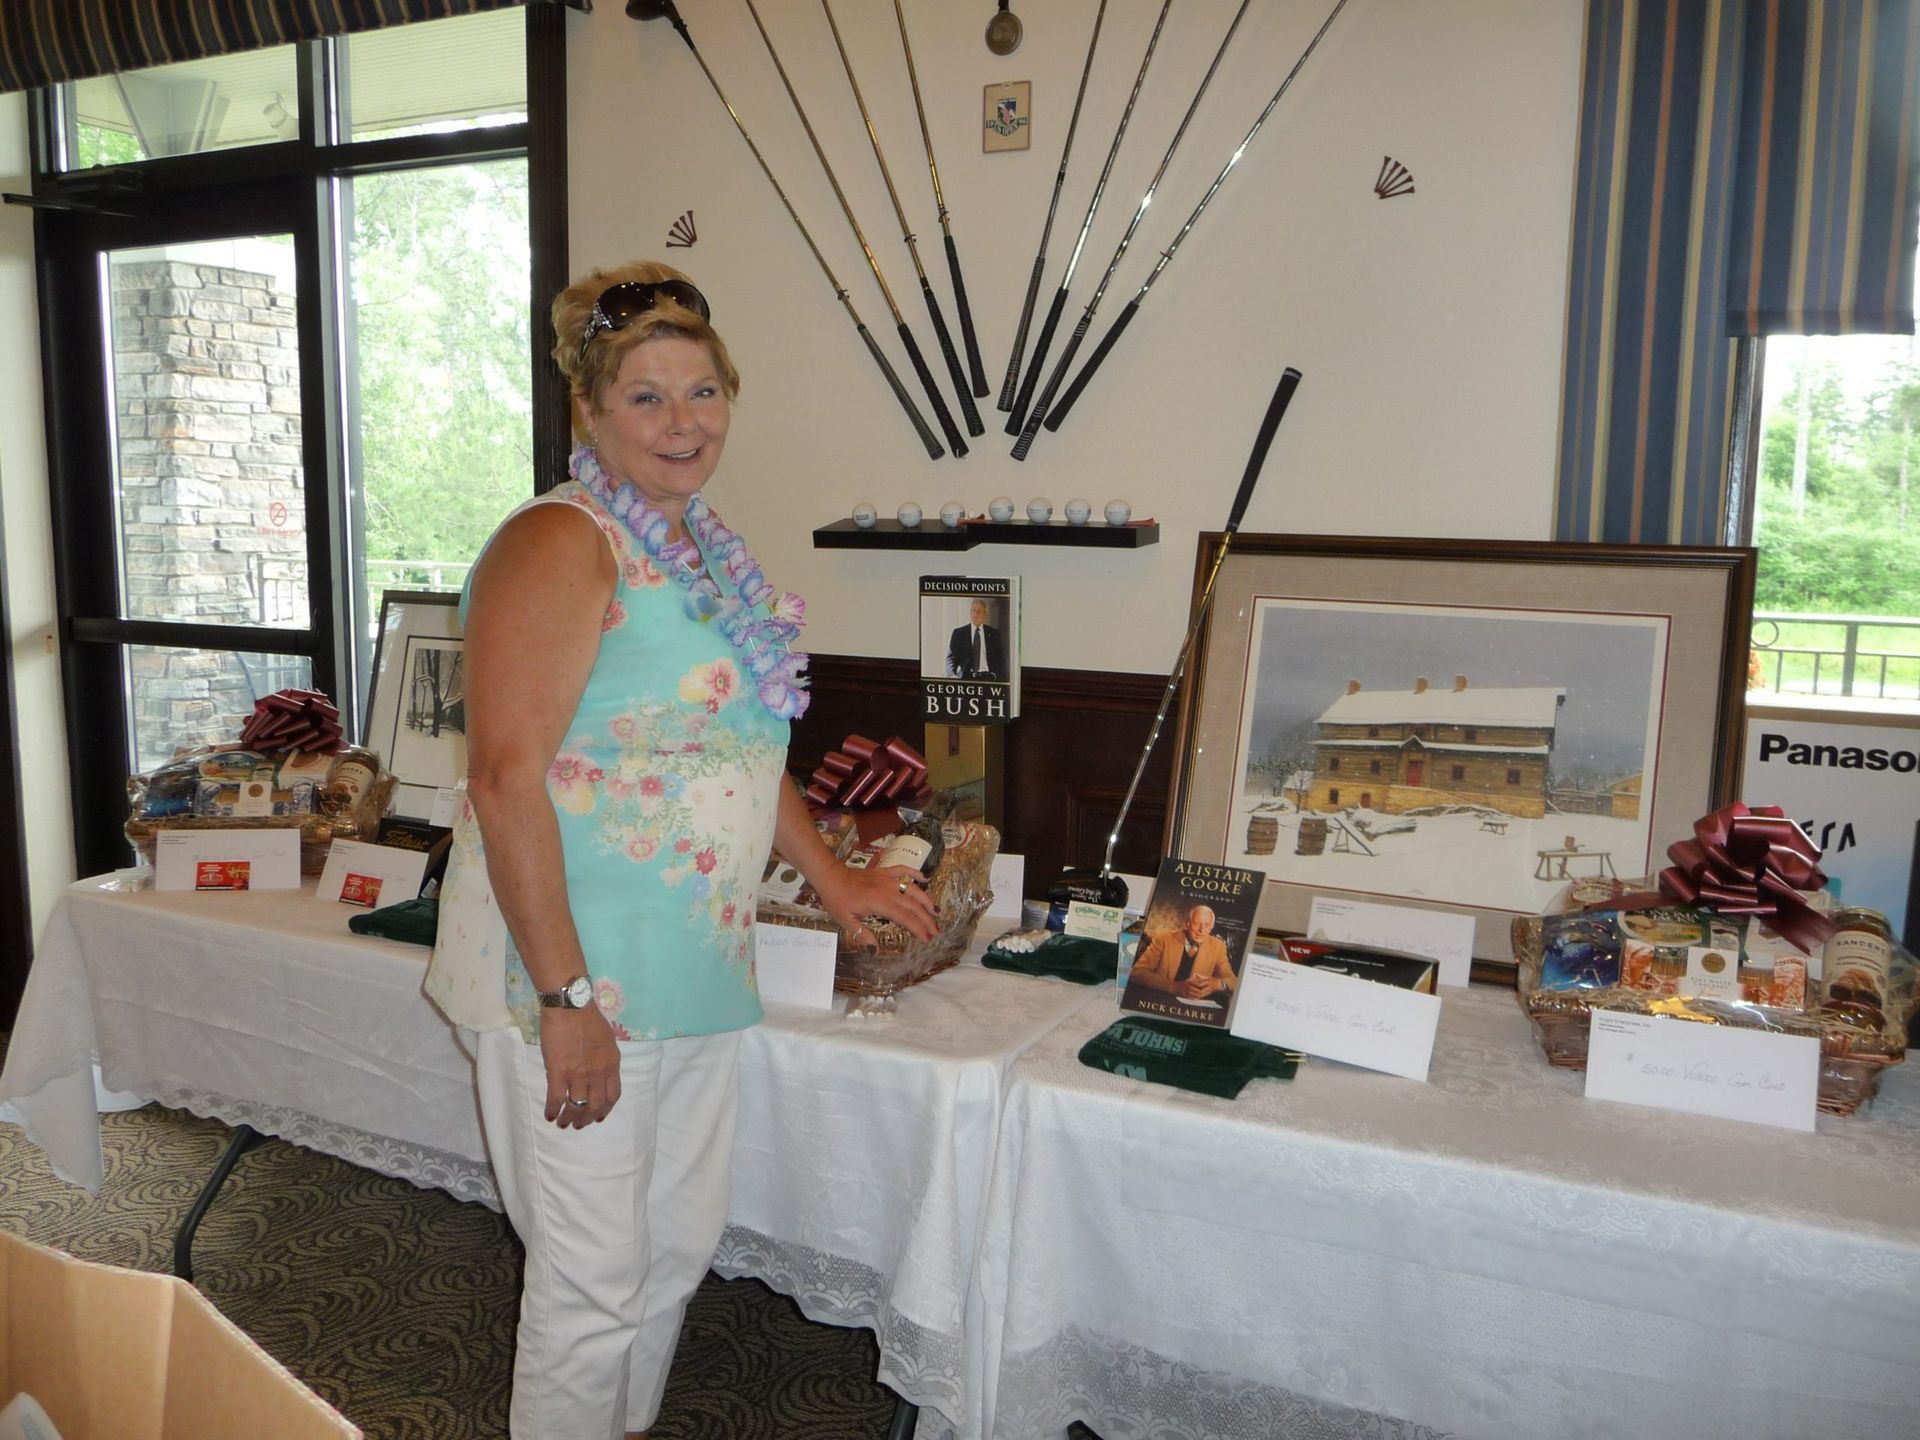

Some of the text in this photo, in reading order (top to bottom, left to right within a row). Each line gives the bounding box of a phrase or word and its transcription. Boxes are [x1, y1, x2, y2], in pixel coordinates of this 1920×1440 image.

[924, 582, 1006, 592] DECISION POINTS
[926, 684, 1006, 697] GEORGE W.
[926, 696, 1005, 717] BUSH
[1759, 733, 1920, 773] Panaso
[1175, 862, 1253, 884] ALISTAIR
[1180, 876, 1242, 895] COOKE
[1190, 892, 1235, 903] BIOGRAPHY
[1290, 946, 1311, 954] NEW
[1138, 1000, 1215, 1021] NICK CLARKE
[1123, 1029, 1185, 1052] JOHNS
